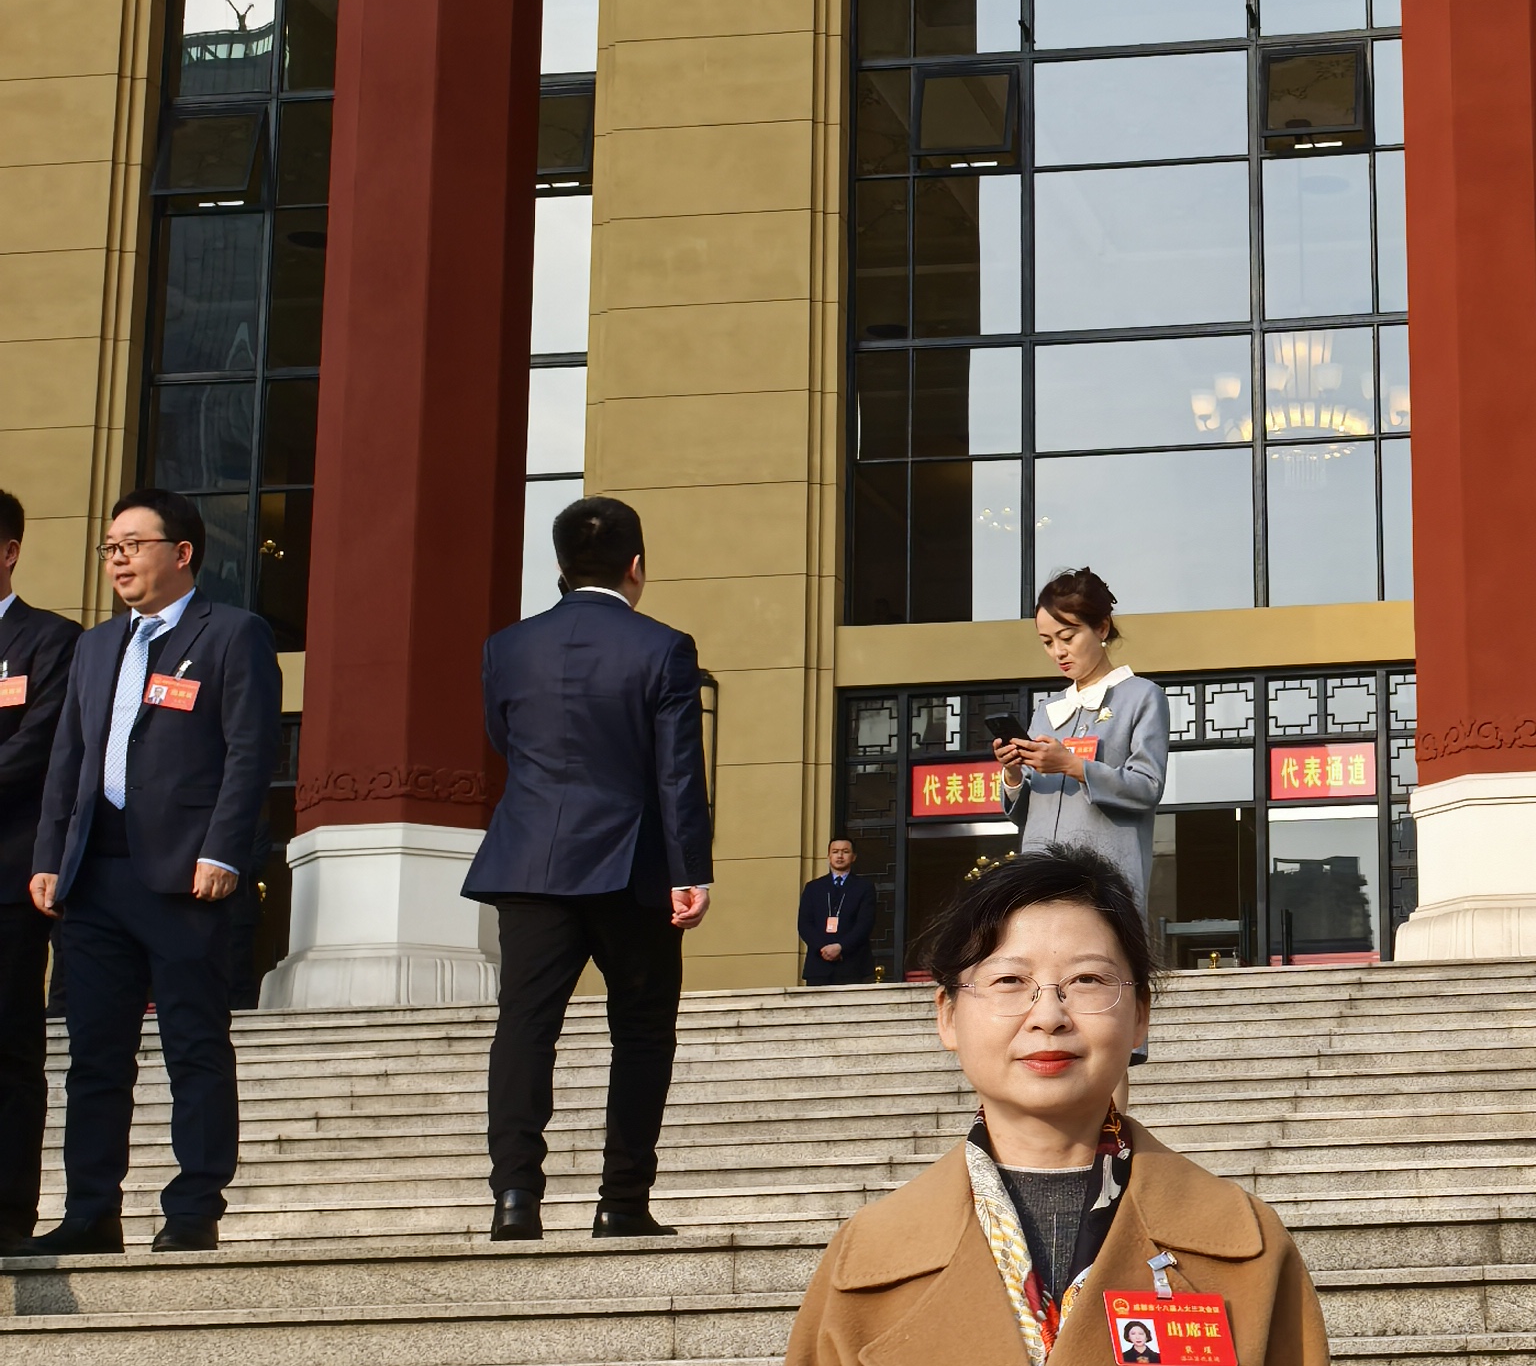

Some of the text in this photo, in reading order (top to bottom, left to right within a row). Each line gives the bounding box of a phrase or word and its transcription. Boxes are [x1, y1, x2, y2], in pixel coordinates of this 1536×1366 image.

[1280, 755, 1366, 789] 代表通道
[1167, 1321, 1222, 1338] 出席证
